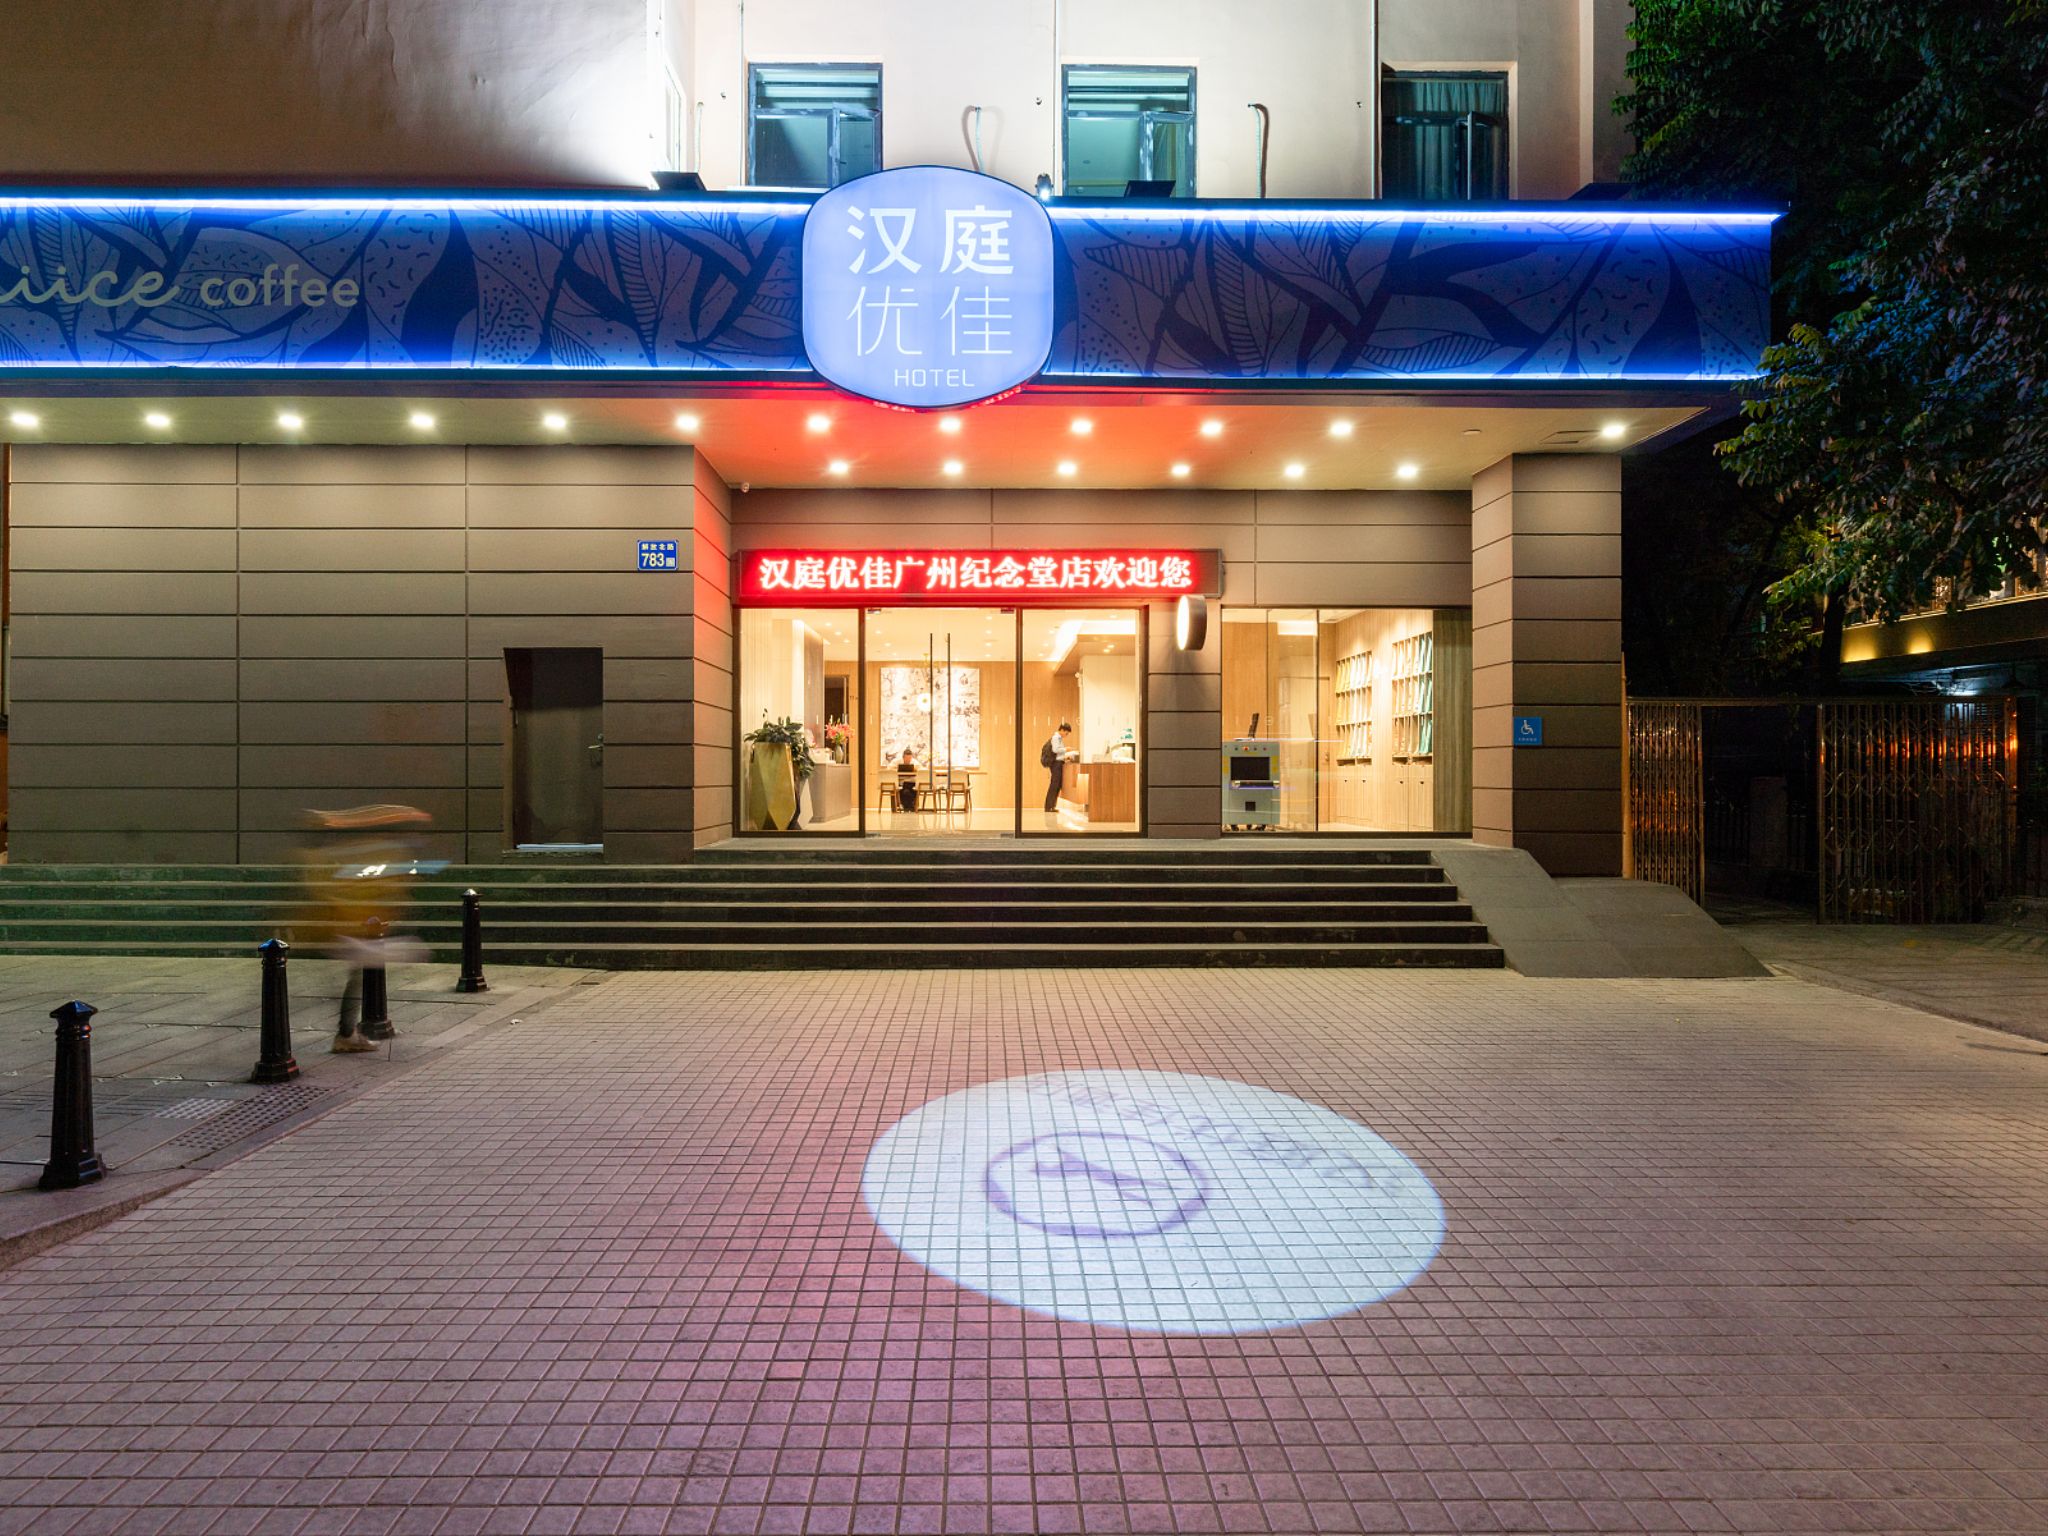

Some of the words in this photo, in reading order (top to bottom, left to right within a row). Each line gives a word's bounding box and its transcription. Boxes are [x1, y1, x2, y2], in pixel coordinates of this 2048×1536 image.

[847, 205, 1014, 275] 汉庭
[0, 264, 180, 307] iice
[200, 263, 360, 308] coffee
[846, 285, 1013, 357] 优佳
[894, 368, 975, 388] HOTEL
[759, 556, 1193, 590] 汉庭优佳广州纪念堂店欢迎您
